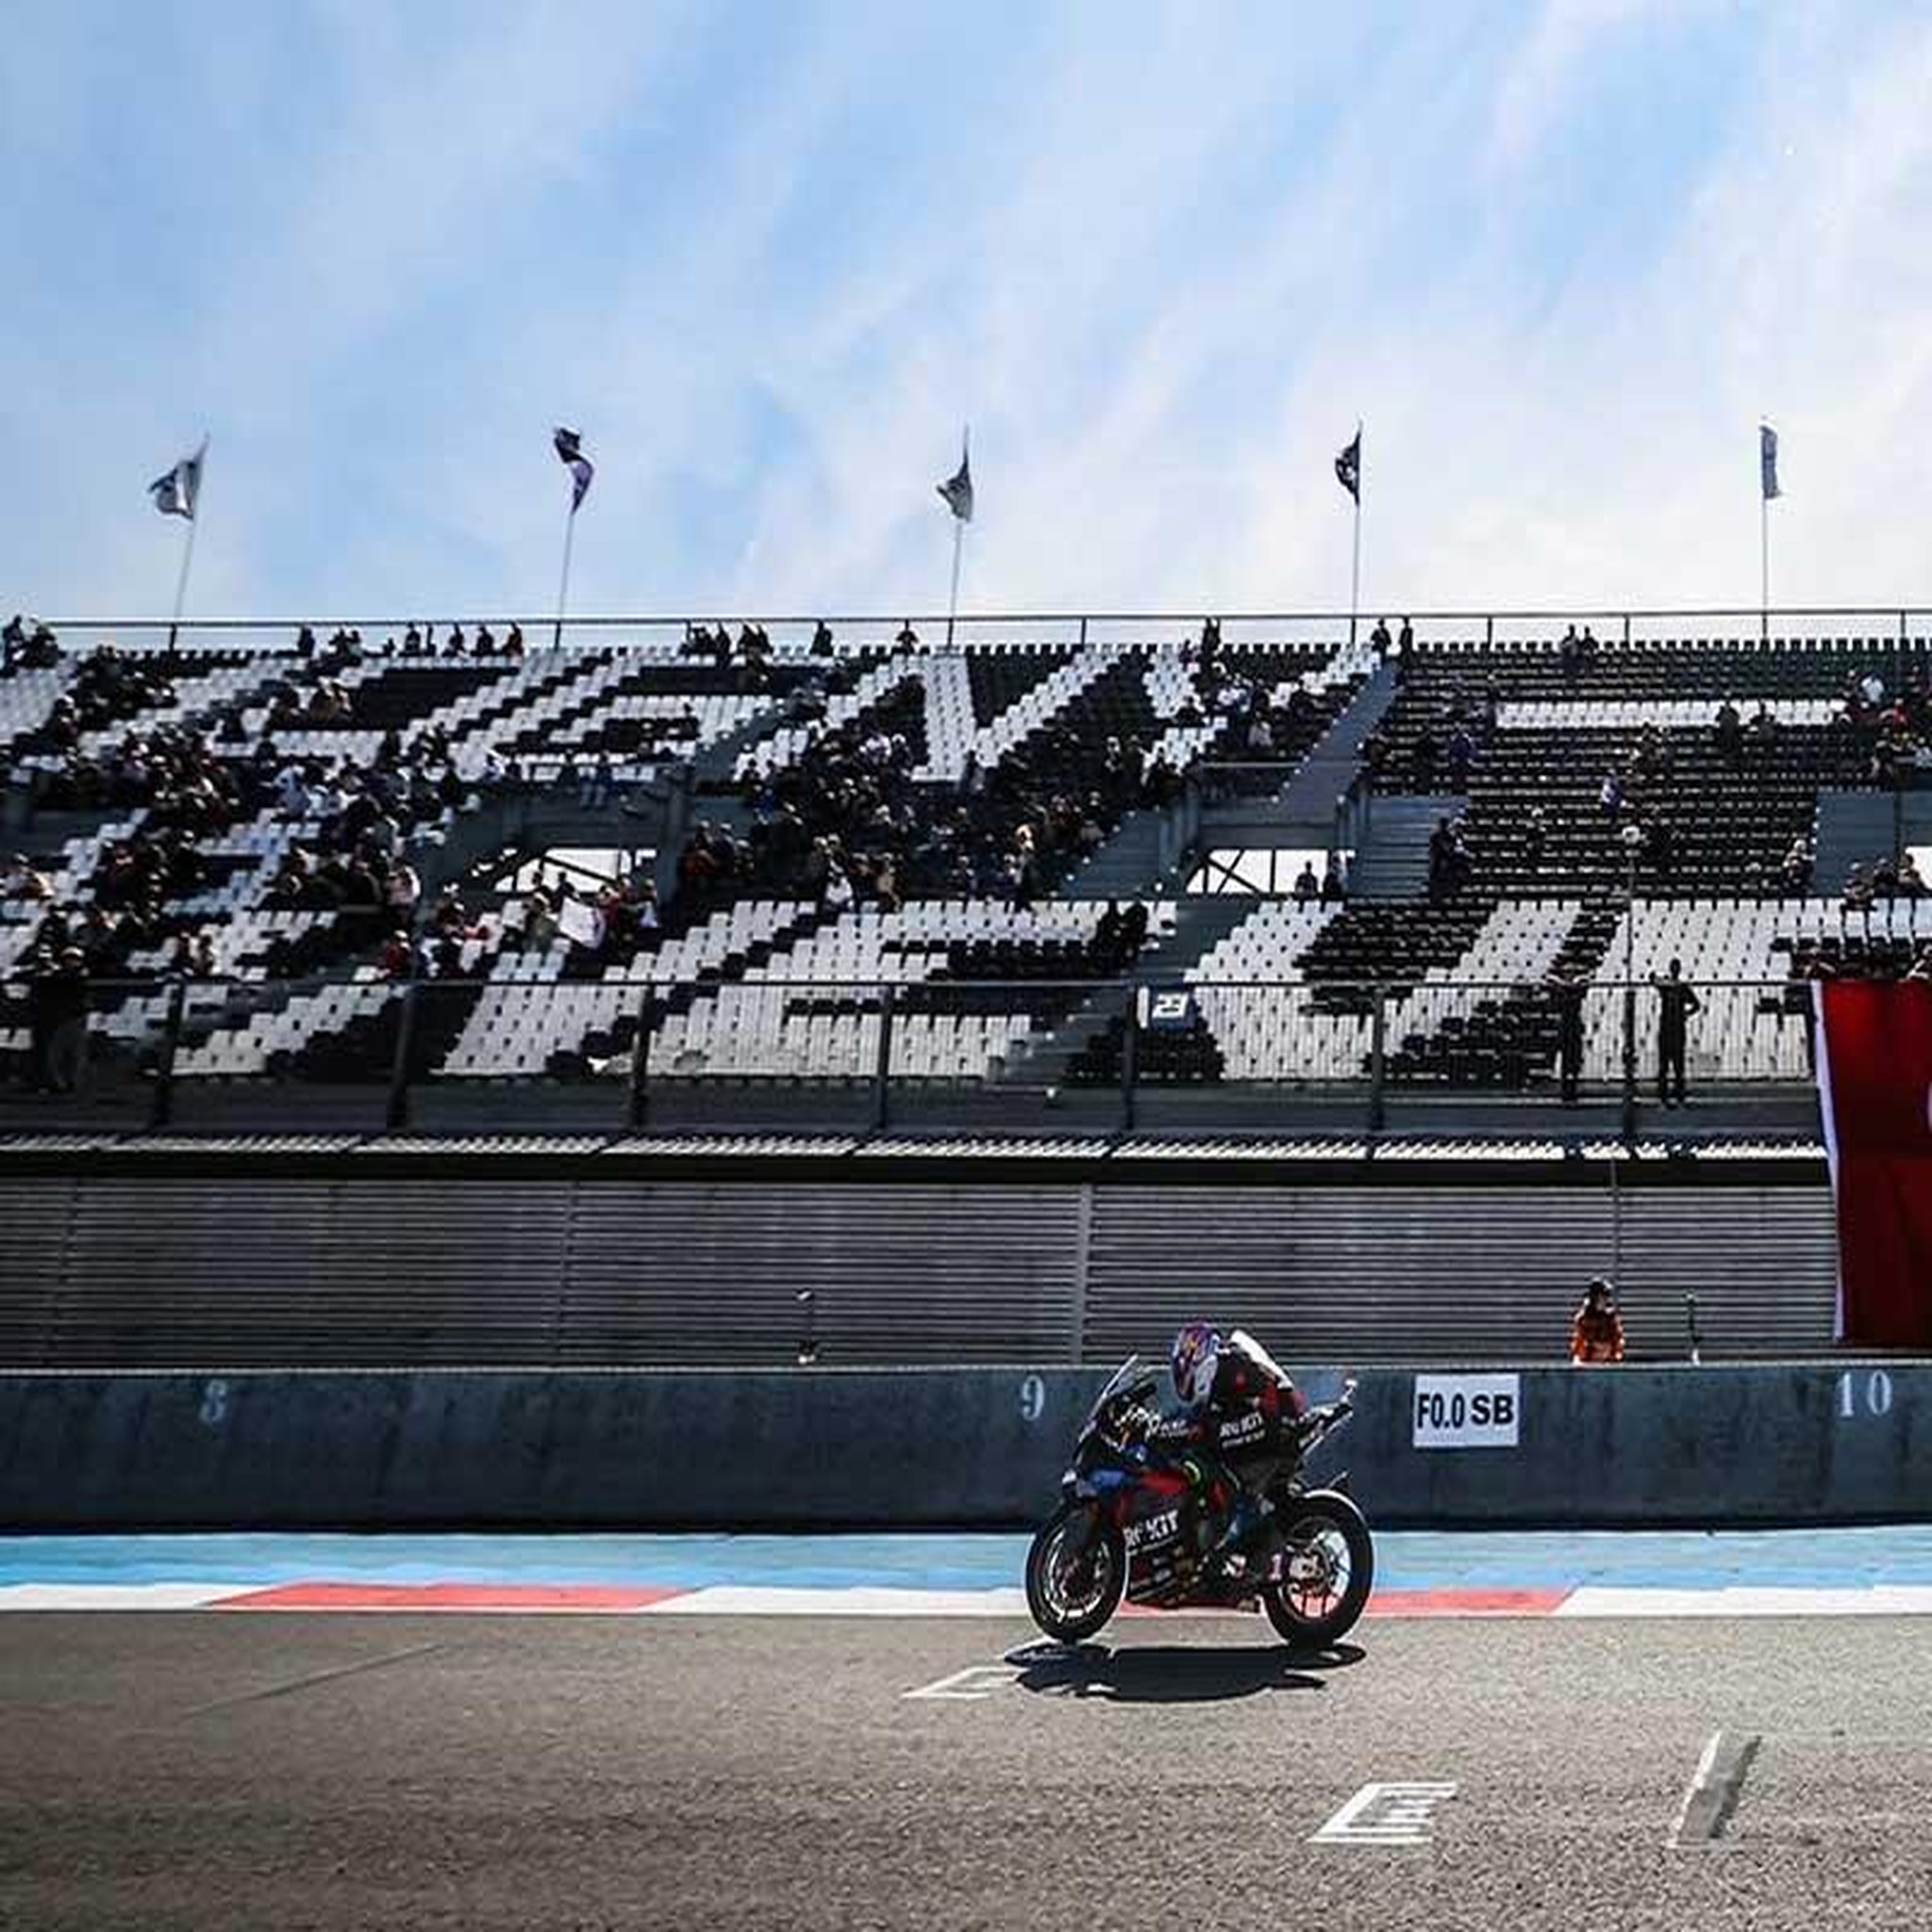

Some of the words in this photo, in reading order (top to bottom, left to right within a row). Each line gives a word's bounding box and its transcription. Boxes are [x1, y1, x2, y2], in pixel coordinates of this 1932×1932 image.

[1022, 1374, 1044, 1422] 9
[1417, 1392, 1465, 1429] F0.0
[1470, 1394, 1514, 1425] SB
[1835, 1370, 1892, 1416] 10
